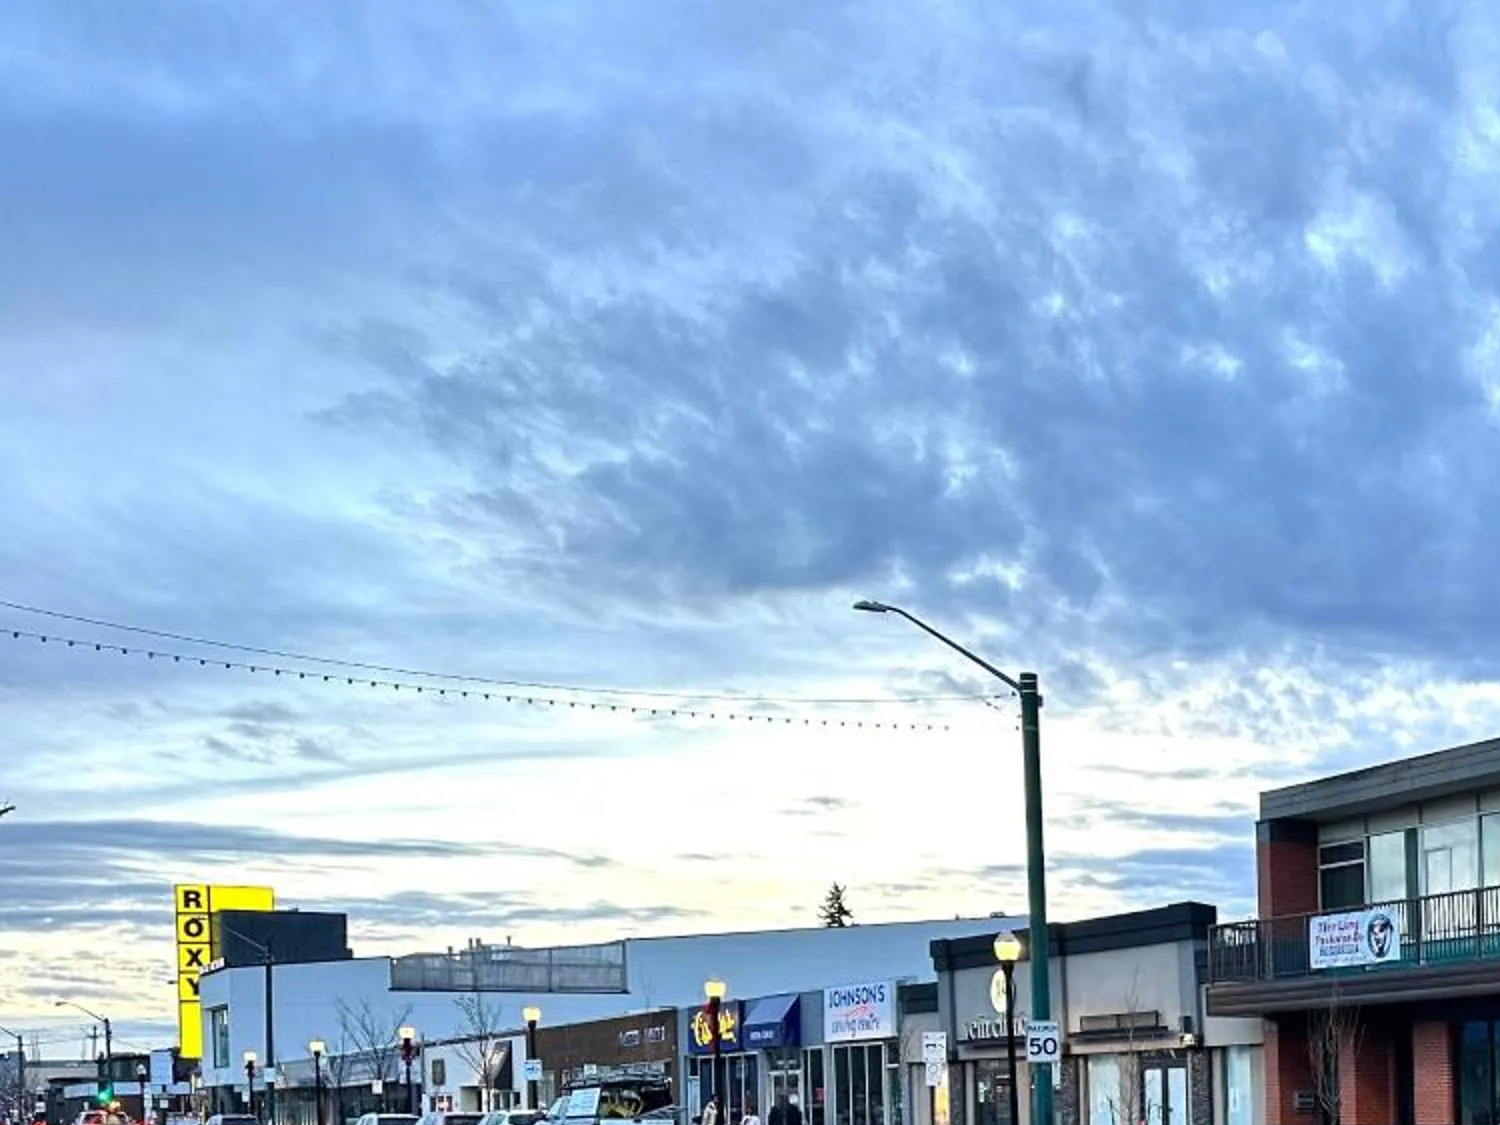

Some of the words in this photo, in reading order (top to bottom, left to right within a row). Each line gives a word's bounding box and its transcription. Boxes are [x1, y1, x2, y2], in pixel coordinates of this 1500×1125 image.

[183, 890, 203, 995] ROXY
[829, 984, 885, 1008] JOHNSON'S
[1030, 1037, 1057, 1055] 50
